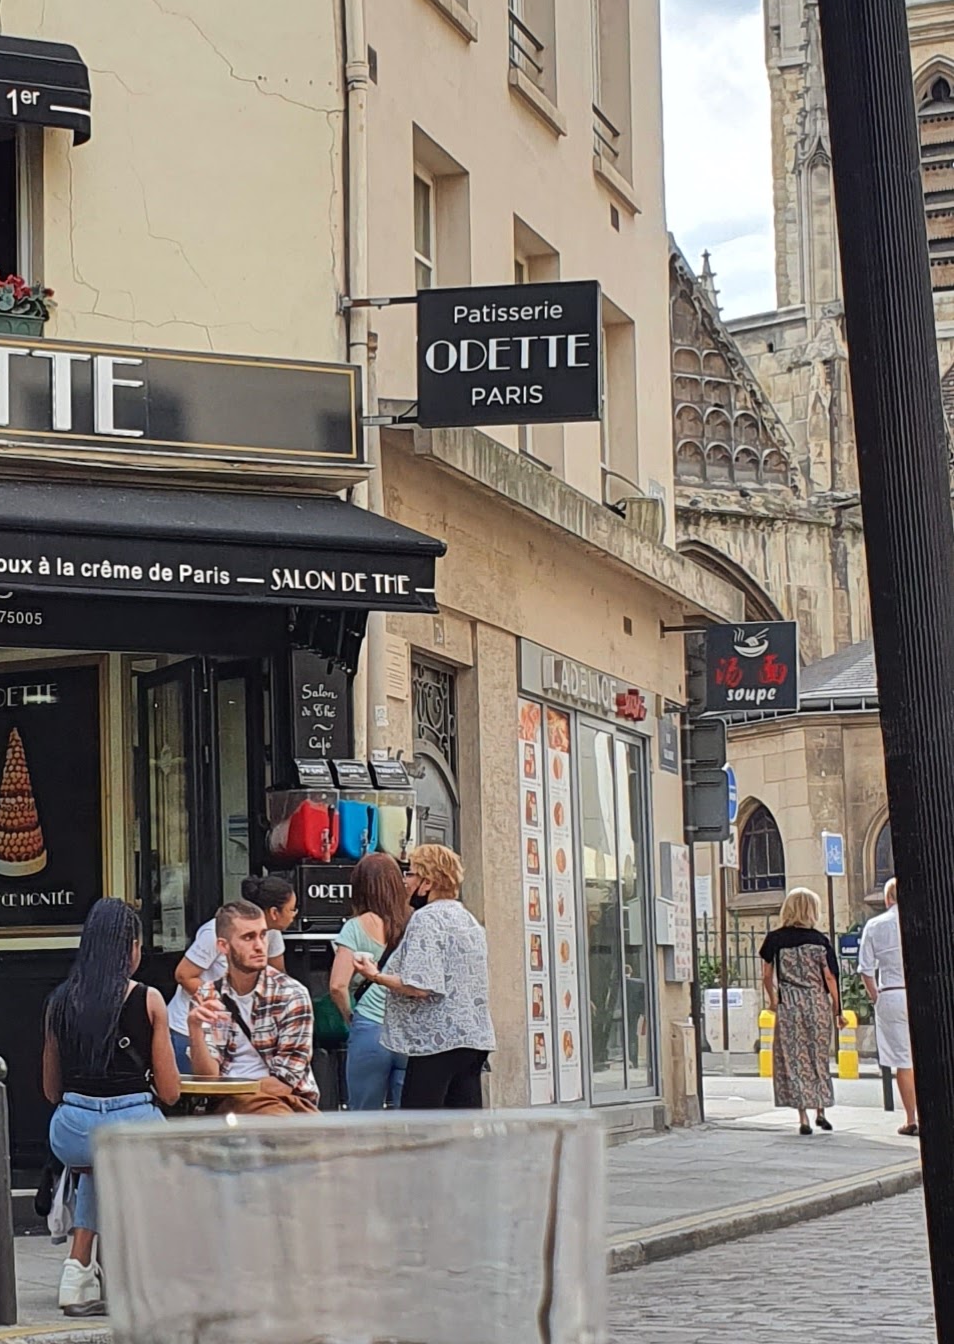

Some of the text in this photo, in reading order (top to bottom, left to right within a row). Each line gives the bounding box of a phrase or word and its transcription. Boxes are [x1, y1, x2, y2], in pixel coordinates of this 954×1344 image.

[7, 89, 40, 115] 1er
[454, 301, 563, 324] Patisserie
[425, 333, 590, 374] ODETTE
[472, 385, 544, 406] PARIS
[39, 556, 50, 575] à
[57, 557, 74, 576] la
[81, 560, 143, 580] crême
[149, 563, 173, 582] de
[179, 564, 230, 584] Paris
[271, 568, 336, 591] SALON
[341, 572, 368, 592] DE
[372, 573, 410, 594] THE
[302, 683, 338, 700] Salon
[726, 687, 776, 705] soupe
[301, 703, 336, 718] de Thé
[309, 736, 332, 756] Café
[20, 889, 75, 906] MONTÉE
[308, 884, 352, 898] ODETT
